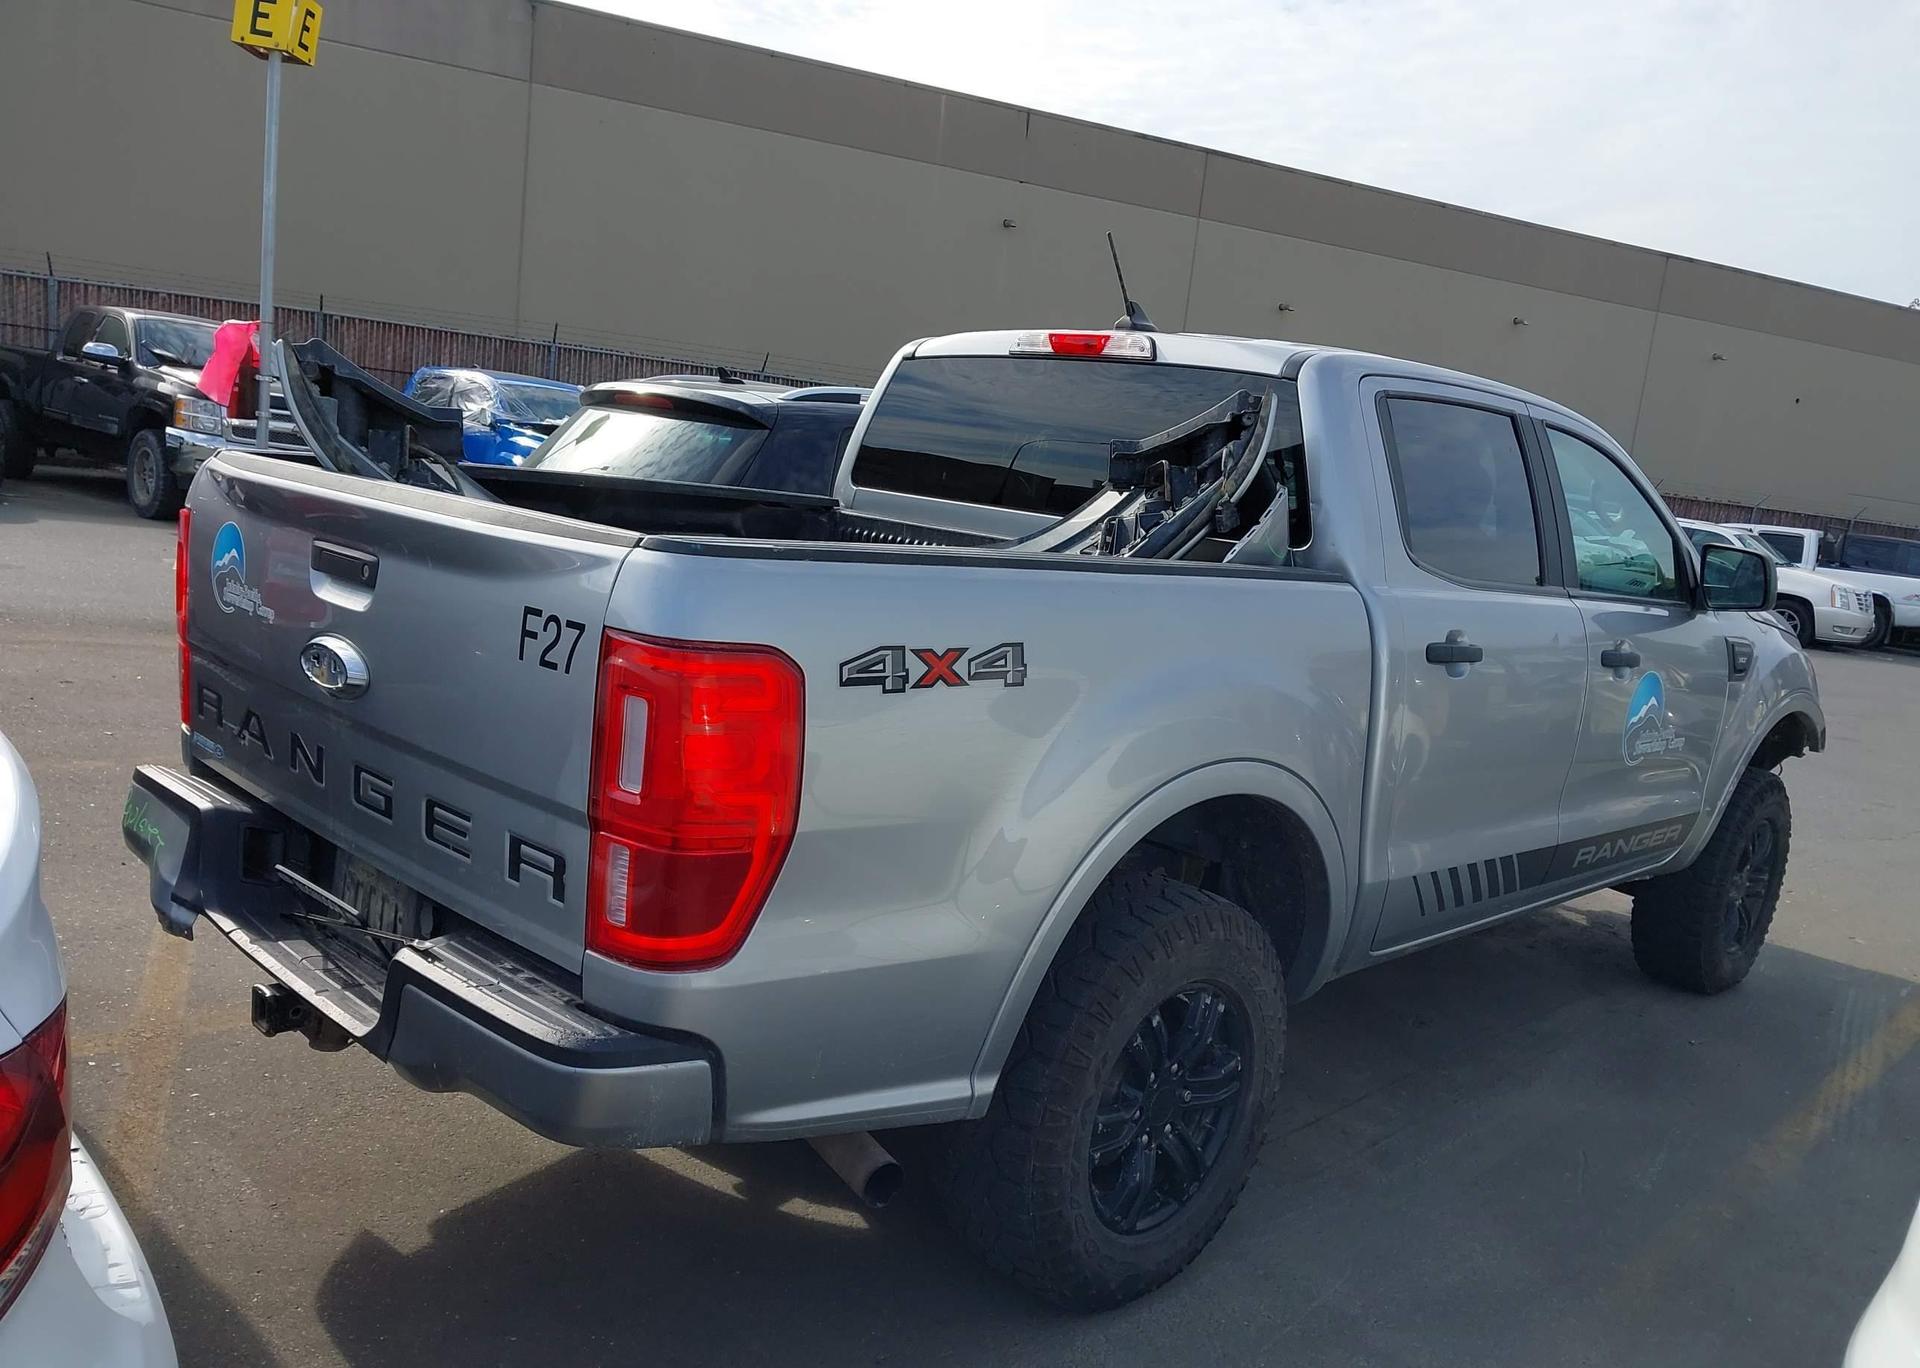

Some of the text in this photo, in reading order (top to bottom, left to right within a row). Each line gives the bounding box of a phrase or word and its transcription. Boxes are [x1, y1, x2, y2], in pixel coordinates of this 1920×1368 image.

[249, 0, 277, 38] E
[298, 8, 316, 52] E
[518, 605, 586, 675] F27
[196, 685, 567, 908] RANGER
[1572, 824, 1682, 868] RANGER
